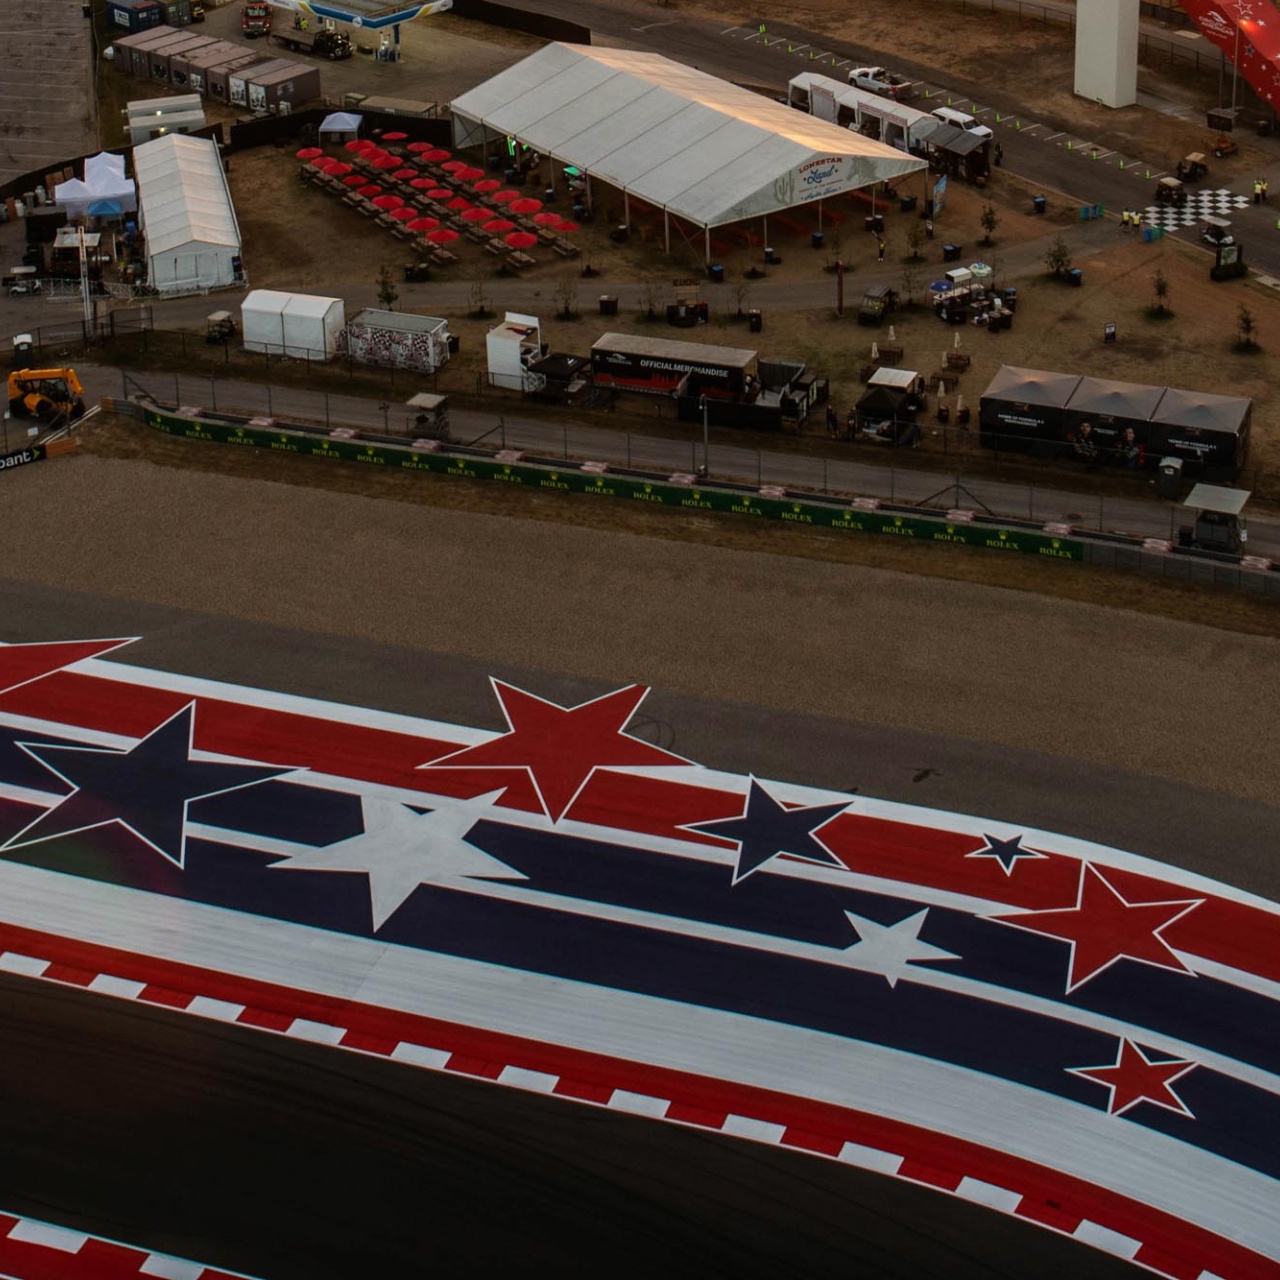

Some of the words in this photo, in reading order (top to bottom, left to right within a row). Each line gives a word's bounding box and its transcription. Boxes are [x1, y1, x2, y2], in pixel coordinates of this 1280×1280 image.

[799, 157, 842, 173] LONESTAR
[807, 165, 835, 184] Land
[640, 359, 673, 370] OFFICIAL
[673, 363, 729, 378] MERCHANDISE
[186, 430, 212, 440] ROLEX
[228, 436, 255, 445] ROLEX
[271, 442, 298, 452] ROLEX
[312, 448, 341, 458] ROLEX
[357, 454, 385, 464] ROLEX
[402, 460, 430, 471] ROLEX
[448, 467, 476, 477] ROLEX
[494, 472, 522, 483] ROLEX
[541, 479, 569, 490] ROLEX
[585, 485, 615, 496] ROLEX
[633, 492, 662, 503] ROLEX
[682, 498, 712, 509] ROLEX
[732, 504, 762, 516] ROLEX
[781, 511, 813, 523] ROLEX
[832, 518, 863, 530] ROLEX
[882, 525, 915, 537] ROLEX
[934, 532, 966, 544] ROLEX
[986, 539, 1020, 551] ROLEX
[1040, 546, 1072, 560] ROLEX
